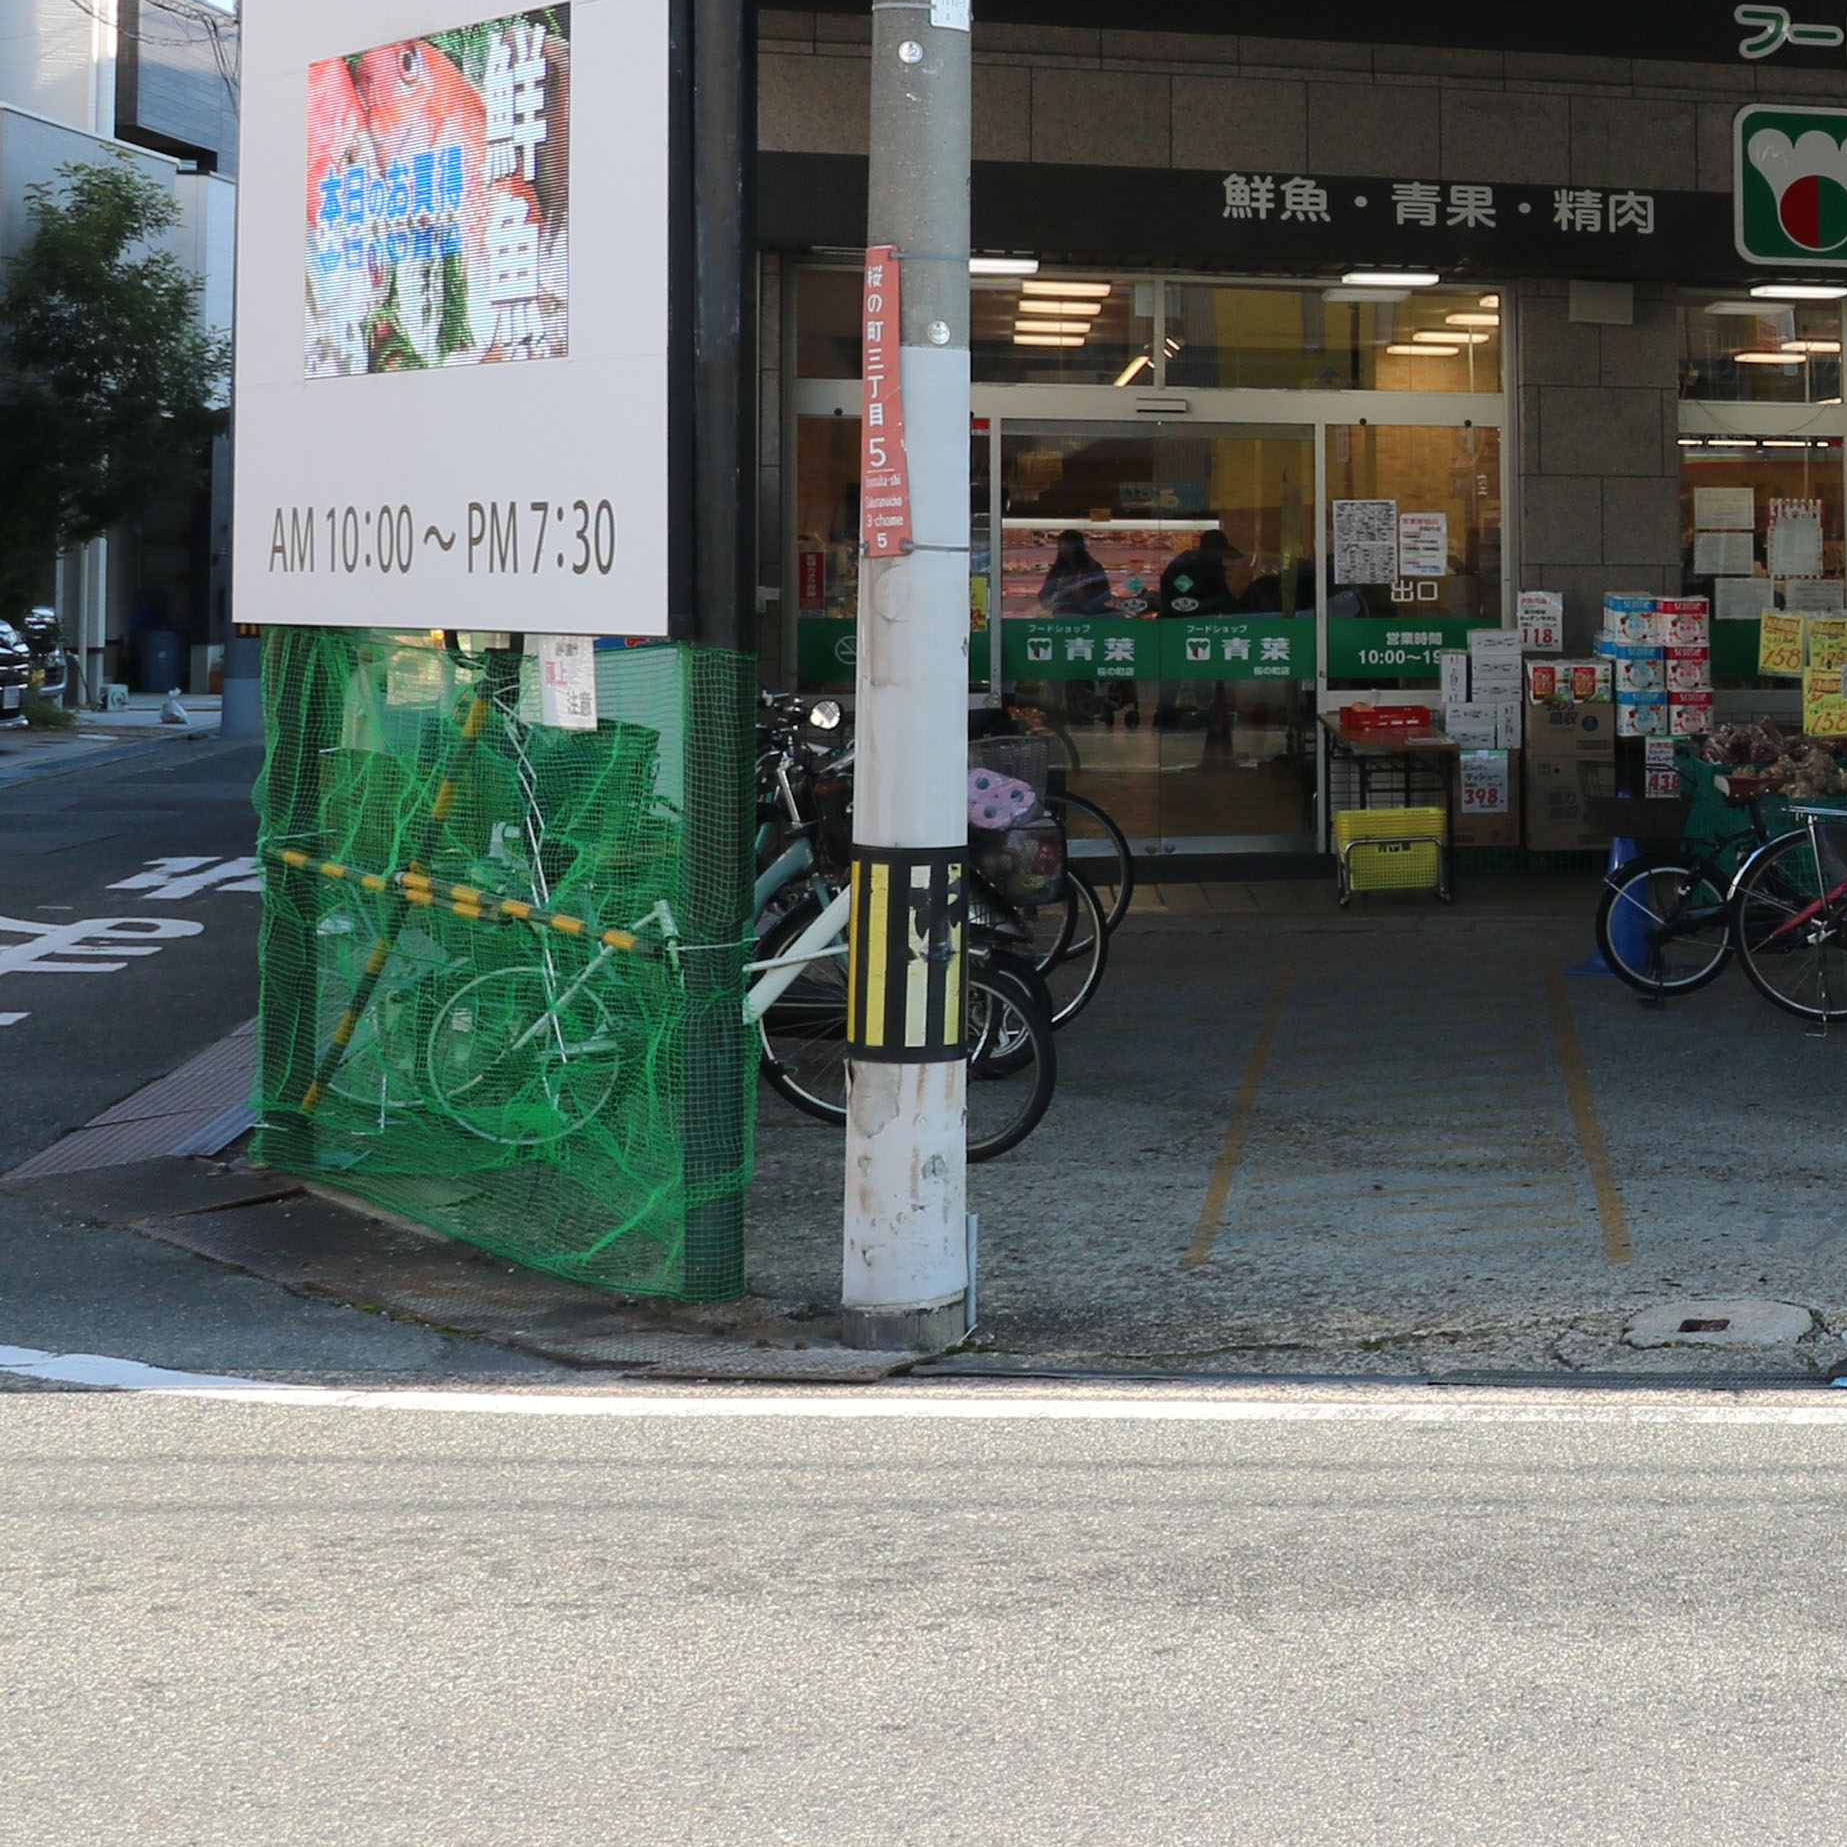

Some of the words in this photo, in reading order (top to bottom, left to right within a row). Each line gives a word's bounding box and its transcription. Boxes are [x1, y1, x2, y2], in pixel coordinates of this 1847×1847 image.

[317, 143, 466, 228] 本日のお買得
[482, 23, 550, 357] 鮮魚
[867, 265, 885, 427] 桜の町三丁目
[869, 437, 887, 468] 5
[269, 507, 315, 573] AM
[326, 504, 414, 574] 10:00
[468, 501, 518, 574] PM
[531, 498, 615, 575] 7:30
[876, 532, 888, 549] 5
[1391, 579, 1438, 601] 出口
[1028, 624, 1090, 634] フードショップ
[1187, 624, 1247, 634] フードショップ
[1386, 632, 1443, 646] 営業時間
[1523, 628, 1552, 643] 118
[1064, 637, 1135, 661] 青葉
[1222, 637, 1290, 661] 青葉
[1464, 788, 1498, 805] 398
